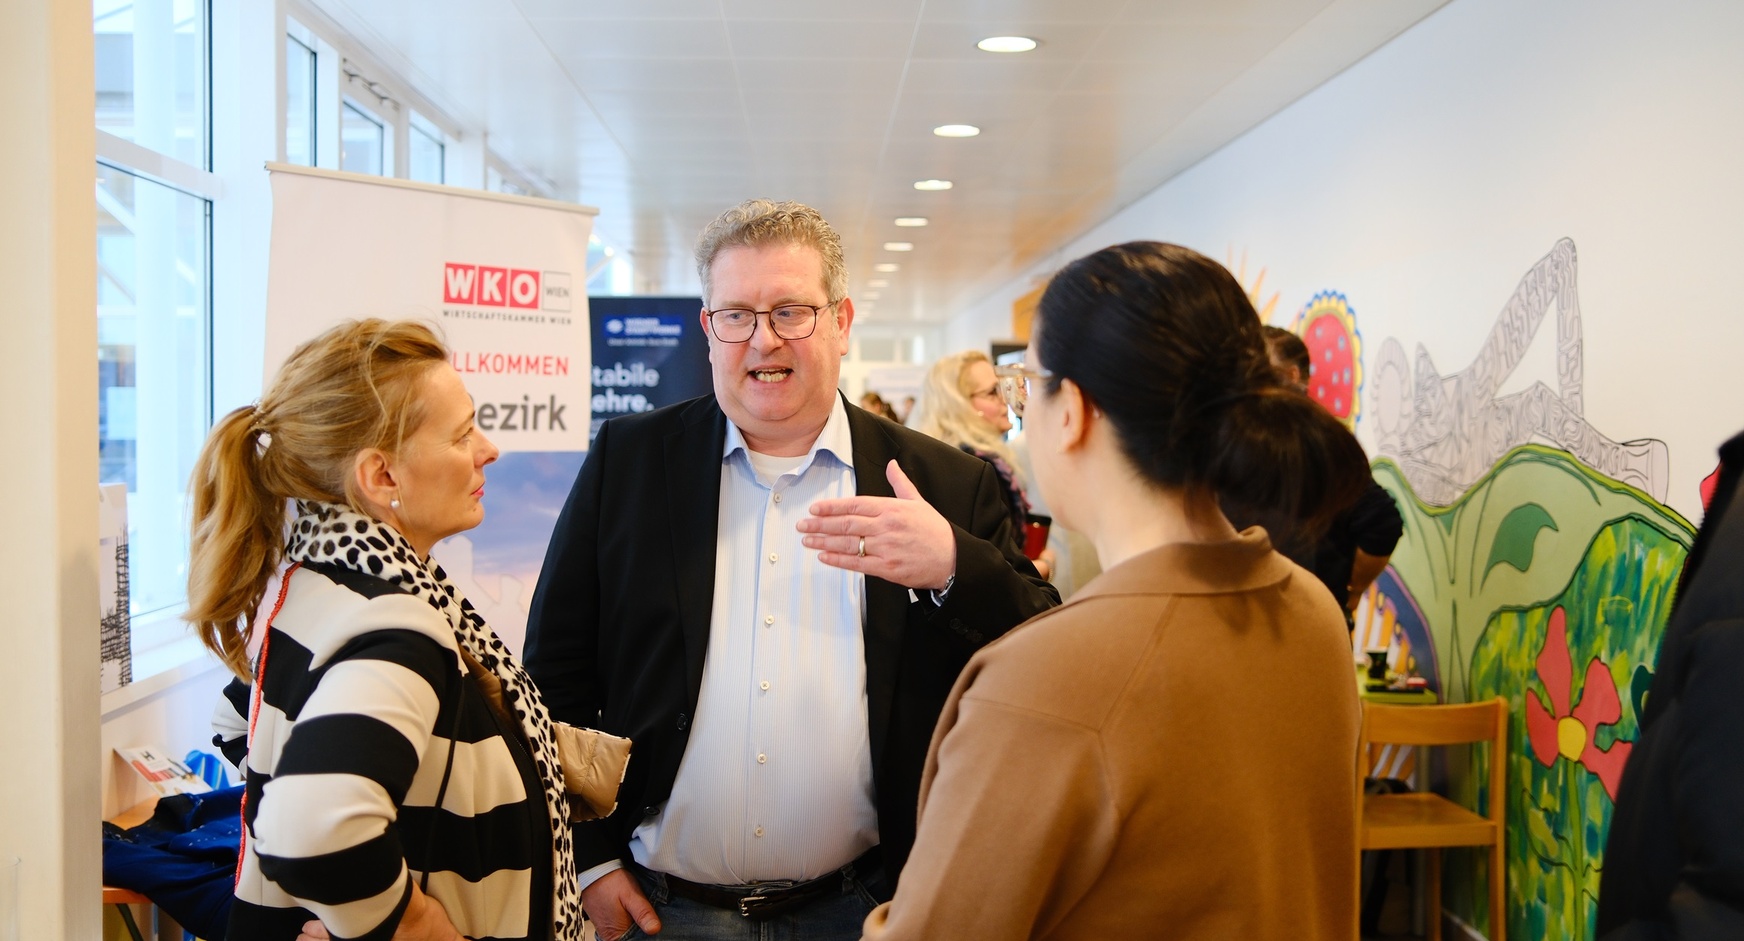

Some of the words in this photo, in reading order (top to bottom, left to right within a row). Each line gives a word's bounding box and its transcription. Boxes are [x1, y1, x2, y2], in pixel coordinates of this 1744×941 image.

[445, 265, 538, 306] WKO
[546, 286, 570, 299] WIEN
[443, 309, 545, 324] WIRTSCHAFTSKAMMER
[550, 316, 573, 326] WIEN
[452, 350, 570, 377] LLKOMMEN
[591, 361, 660, 388] tabile
[472, 394, 567, 432] ezirk
[591, 387, 655, 413] ehre.
